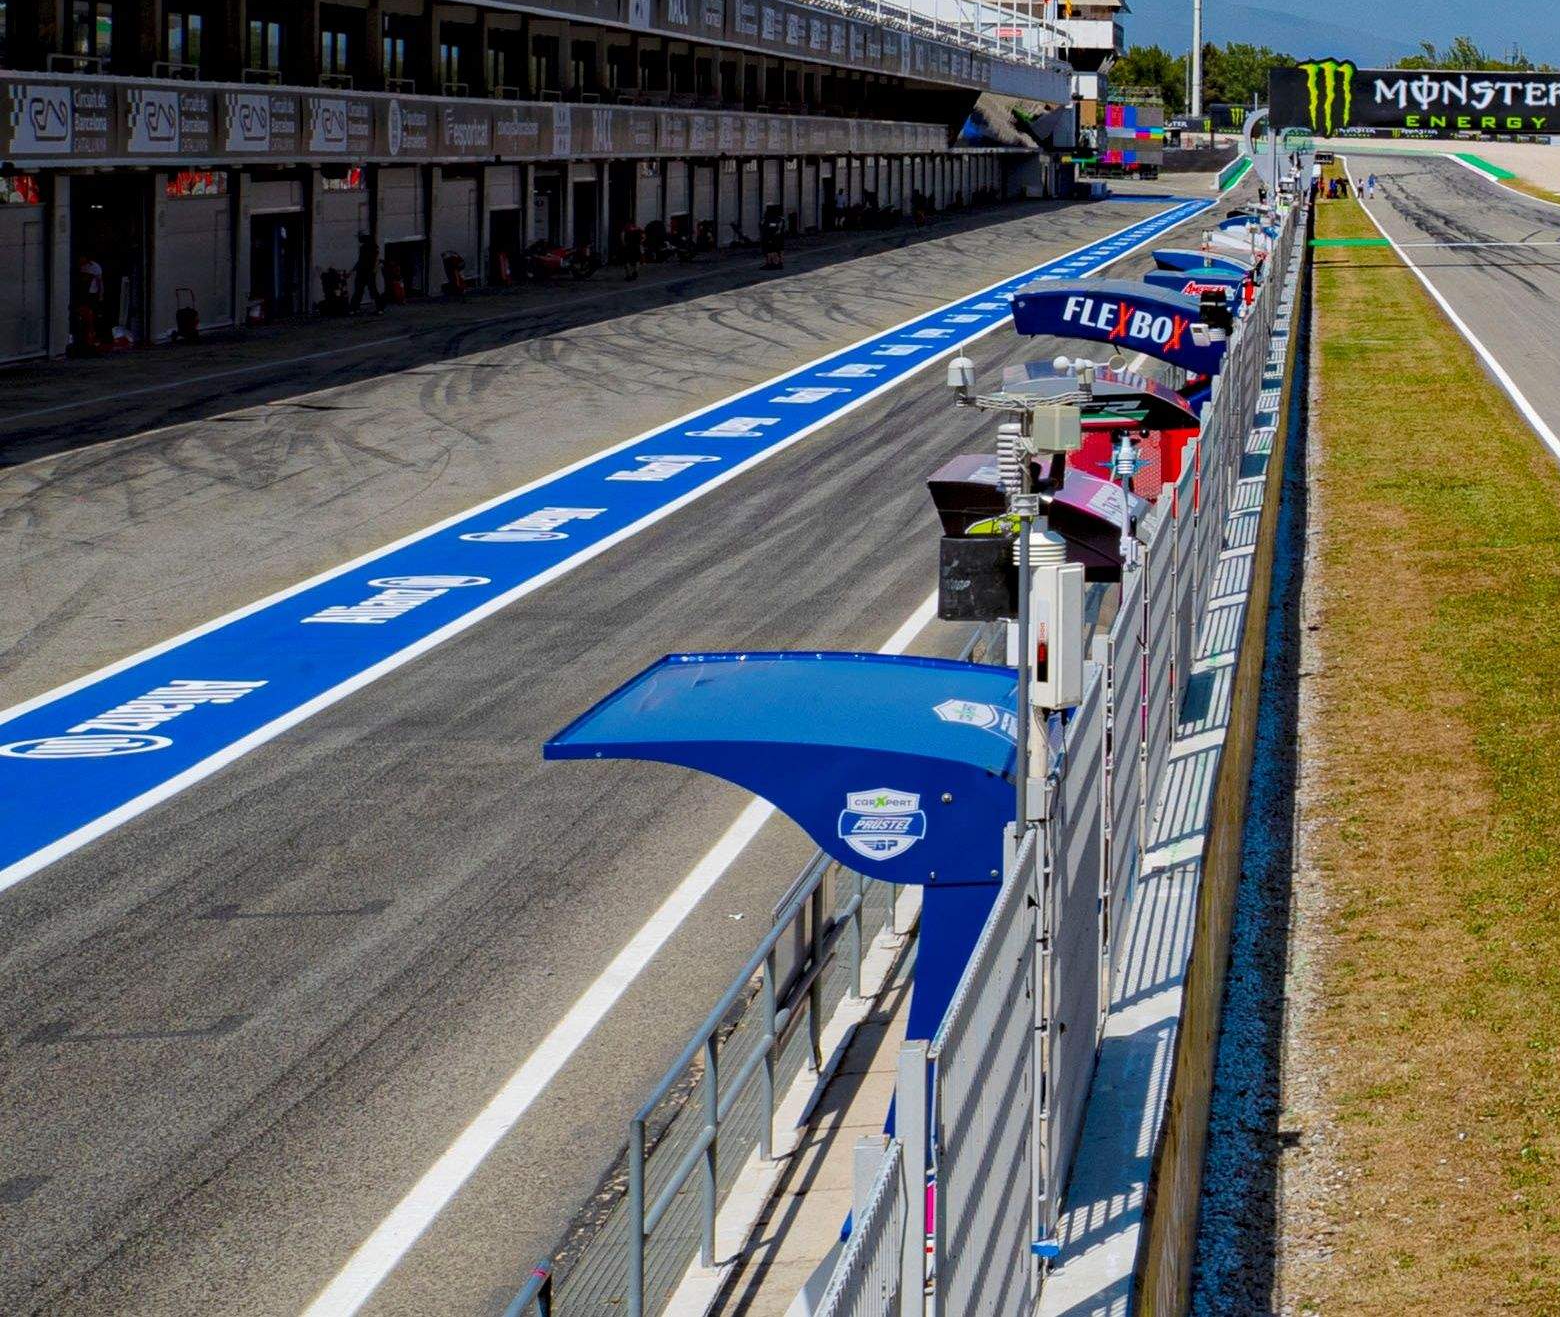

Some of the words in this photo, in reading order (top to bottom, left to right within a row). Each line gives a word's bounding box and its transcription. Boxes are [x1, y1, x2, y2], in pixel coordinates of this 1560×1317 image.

[1406, 116, 1547, 129] ENERGY
[1062, 296, 1188, 352] FLEXBOX
[874, 840, 898, 851] GP
